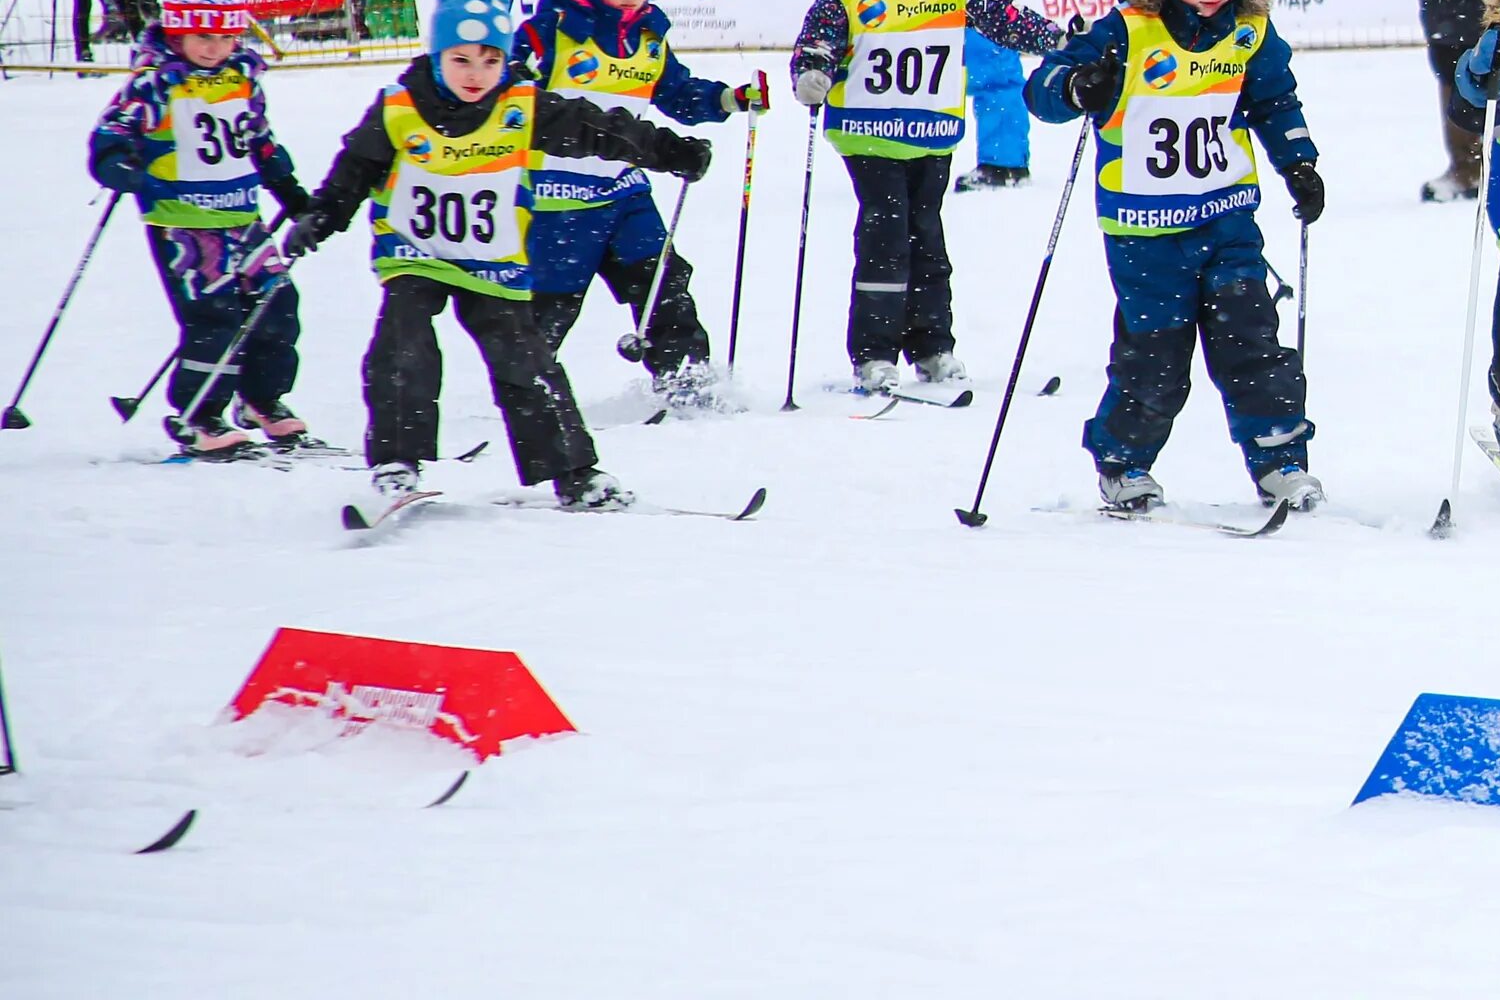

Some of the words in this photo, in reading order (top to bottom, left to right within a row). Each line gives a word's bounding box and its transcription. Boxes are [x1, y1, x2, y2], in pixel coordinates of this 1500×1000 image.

[896, 2, 957, 18] РусГидро
[864, 45, 951, 96] 307
[1190, 58, 1244, 77] РусГидро
[841, 118, 904, 138] ГРЕБНОЙ
[907, 119, 959, 139] СЛАЛОМ
[442, 143, 516, 162] РусГидро
[1146, 116, 1228, 179] 305
[178, 188, 247, 210] РЕБНОЙ
[409, 185, 498, 244] 303
[1117, 205, 1198, 229] ГРЕБНОЙ
